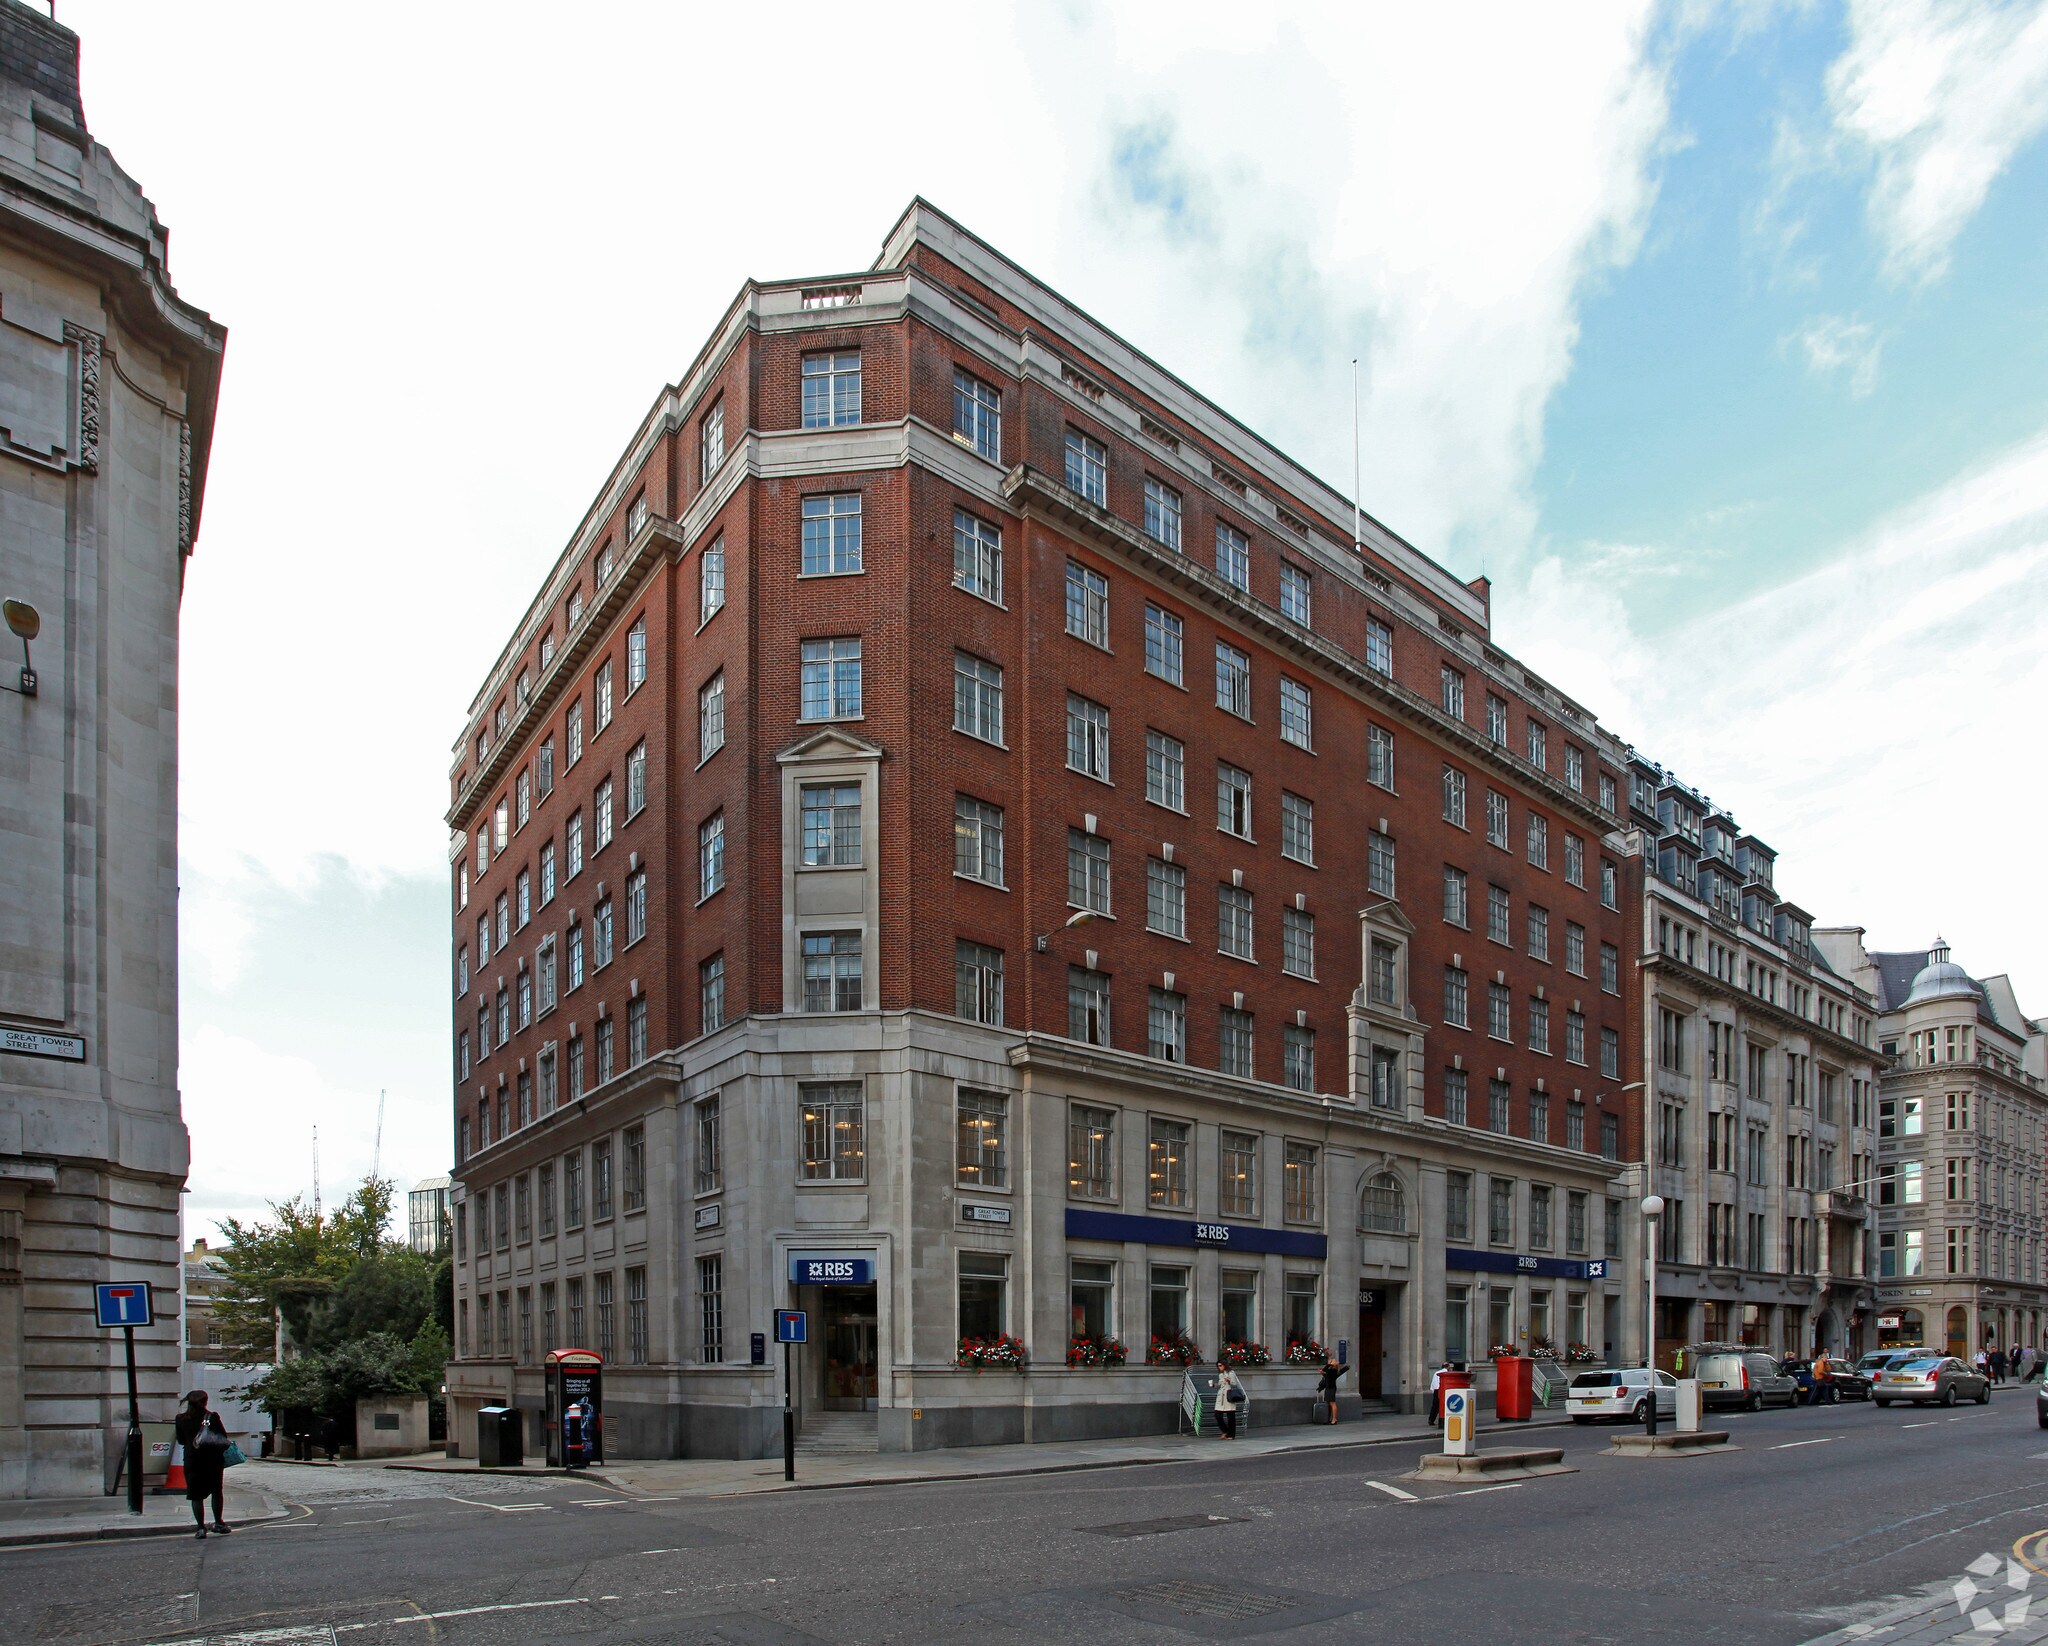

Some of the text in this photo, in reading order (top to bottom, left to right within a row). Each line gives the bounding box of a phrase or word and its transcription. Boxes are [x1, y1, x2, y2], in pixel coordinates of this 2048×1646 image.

[6, 1032, 74, 1047] GREAT TOWER
[6, 1040, 75, 1055] STREET EC3
[1208, 1225, 1229, 1240] RBS
[825, 1262, 853, 1276] RBS
[1525, 1257, 1538, 1268] RBS
